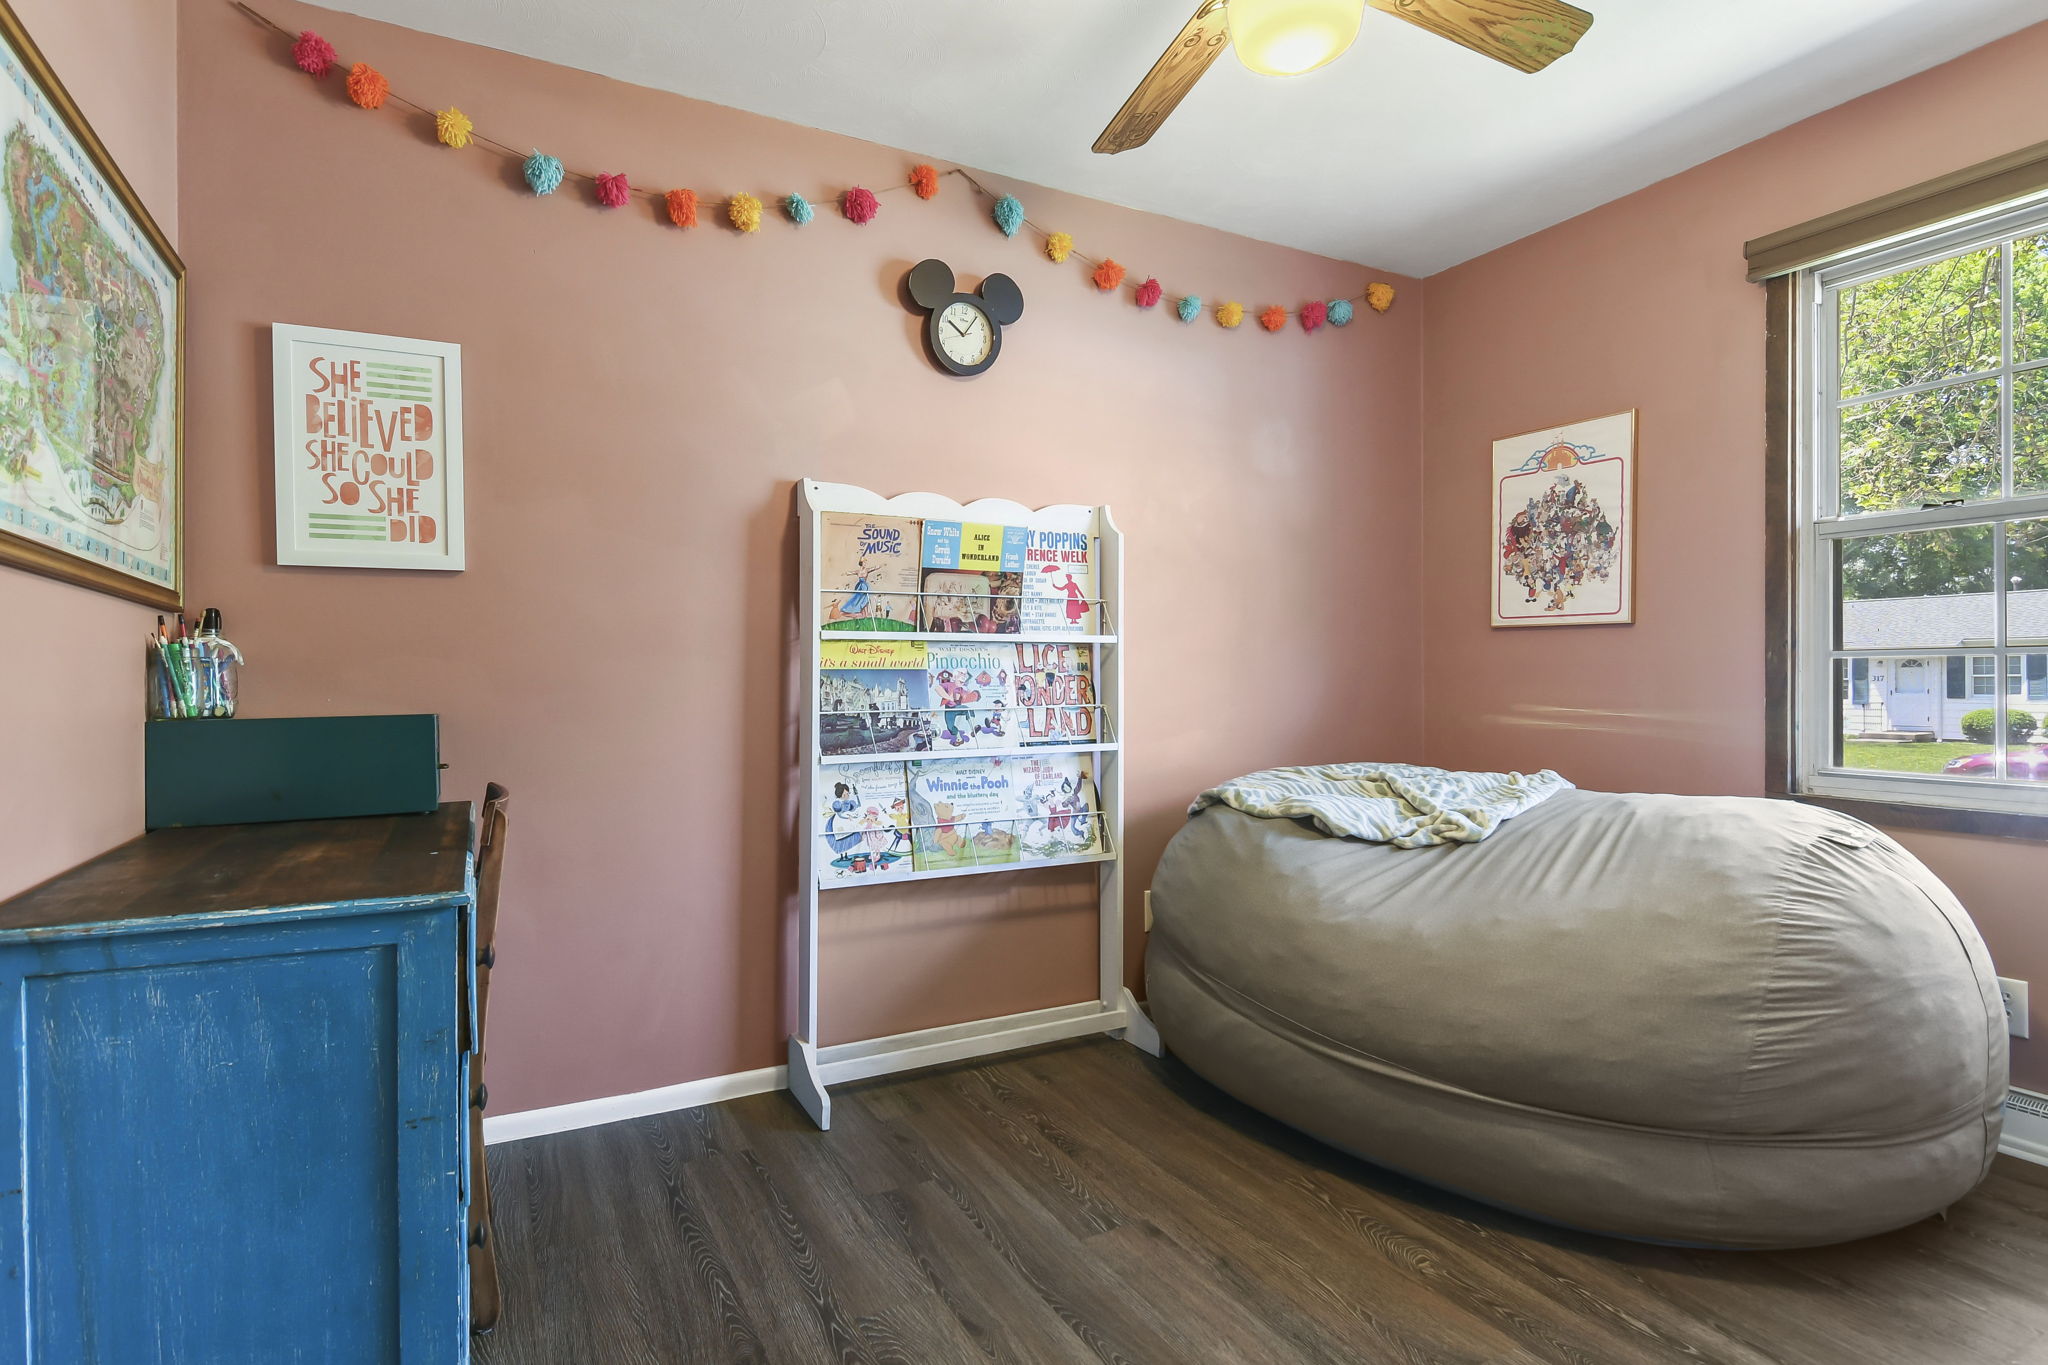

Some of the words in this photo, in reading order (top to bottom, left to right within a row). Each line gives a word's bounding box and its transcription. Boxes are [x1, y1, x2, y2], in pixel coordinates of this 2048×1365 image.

[308, 356, 361, 398] SHE
[305, 439, 349, 472] SHE
[351, 449, 434, 487] COULD
[321, 472, 360, 506] SO
[367, 480, 420, 516] SHE
[389, 515, 437, 544] DID
[857, 528, 900, 541] SOUND
[927, 526, 943, 536] Snow
[943, 527, 960, 537] White
[1040, 531, 1088, 551] POPPINS
[961, 553, 1000, 561] WONDERLAND
[1027, 549, 1058, 562] RENCE
[1061, 550, 1088, 563] WELK
[865, 644, 895, 656] Disney
[1014, 643, 1069, 674] LICE
[1077, 662, 1089, 671] IN
[820, 657, 836, 668] it's
[851, 657, 886, 668] small
[890, 657, 925, 668] world
[927, 652, 1001, 669] Pinocchio
[1027, 707, 1092, 738] LAND
[926, 777, 969, 792] Winnie
[981, 775, 1009, 789] Pooh
